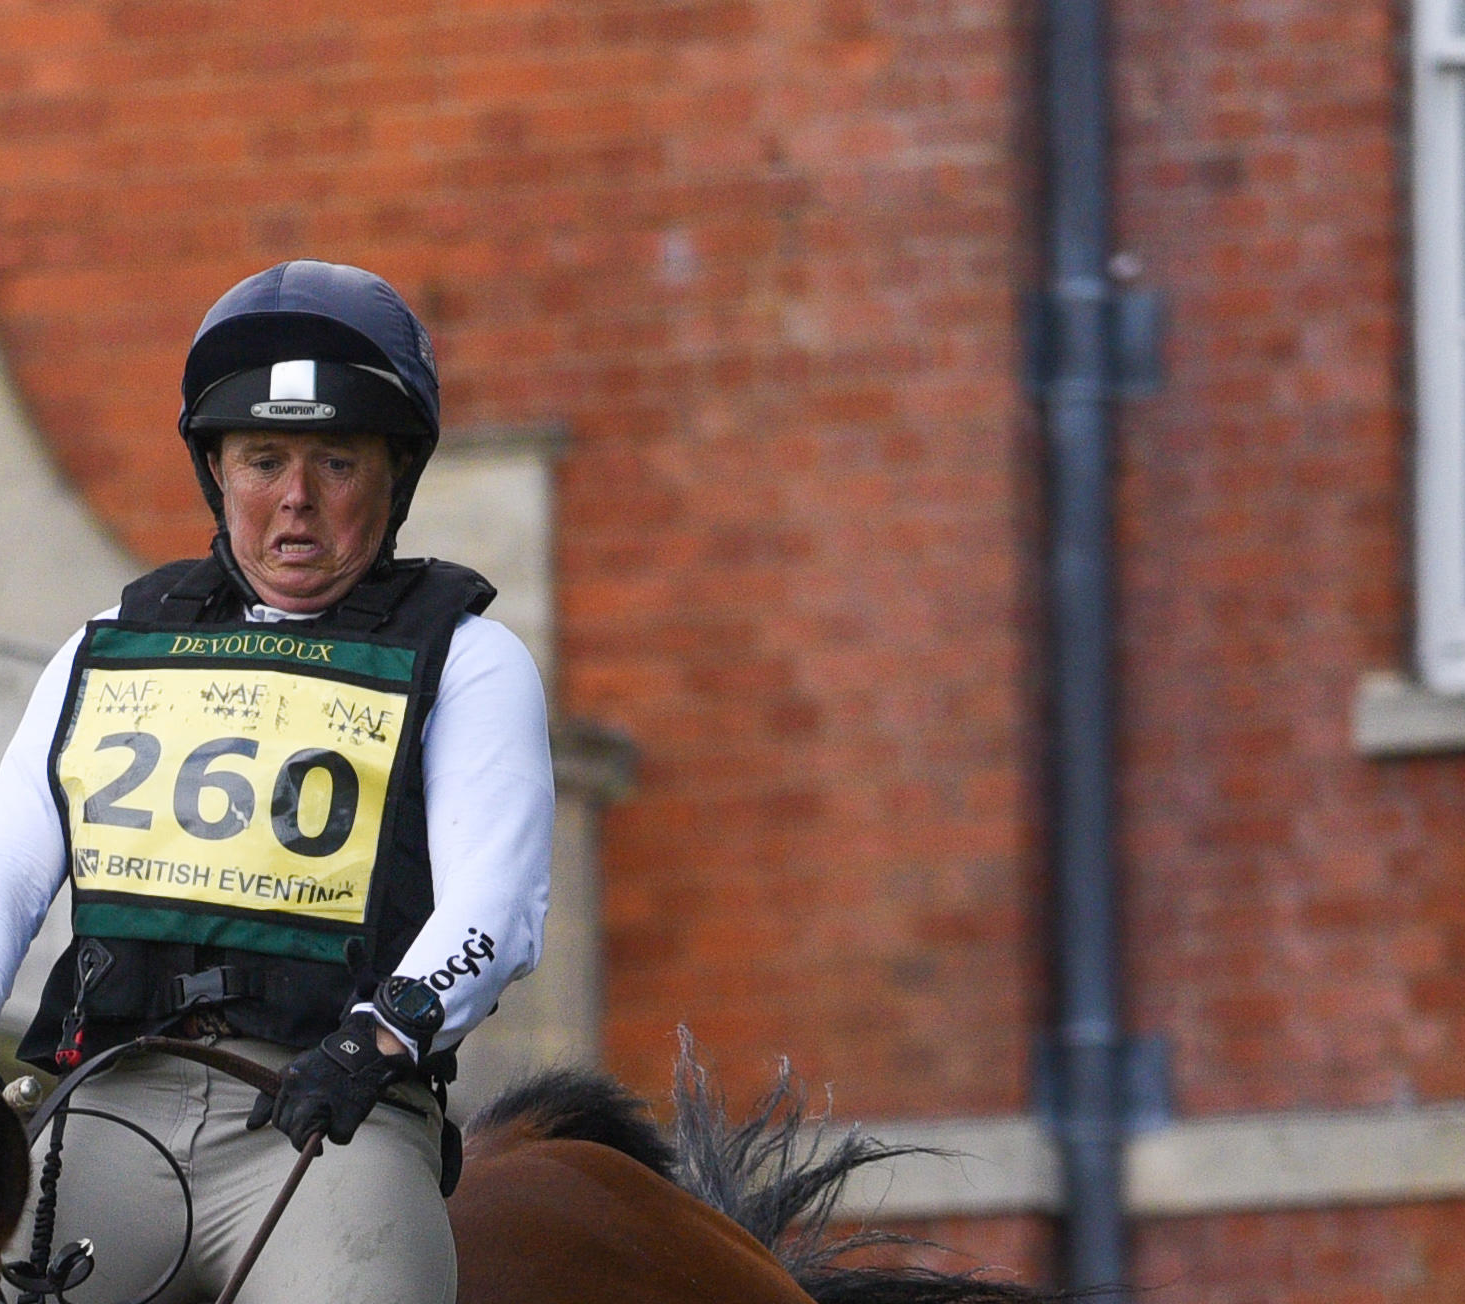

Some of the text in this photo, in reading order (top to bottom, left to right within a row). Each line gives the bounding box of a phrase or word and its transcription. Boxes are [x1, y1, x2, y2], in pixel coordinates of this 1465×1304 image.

[268, 405, 316, 416] CHAMPION
[168, 635, 334, 662] DEVOUCOUX
[99, 680, 157, 702] NAF
[207, 681, 267, 706] NAF
[330, 697, 393, 730] NAF
[82, 731, 359, 858] 260
[106, 855, 211, 887] BRITISH
